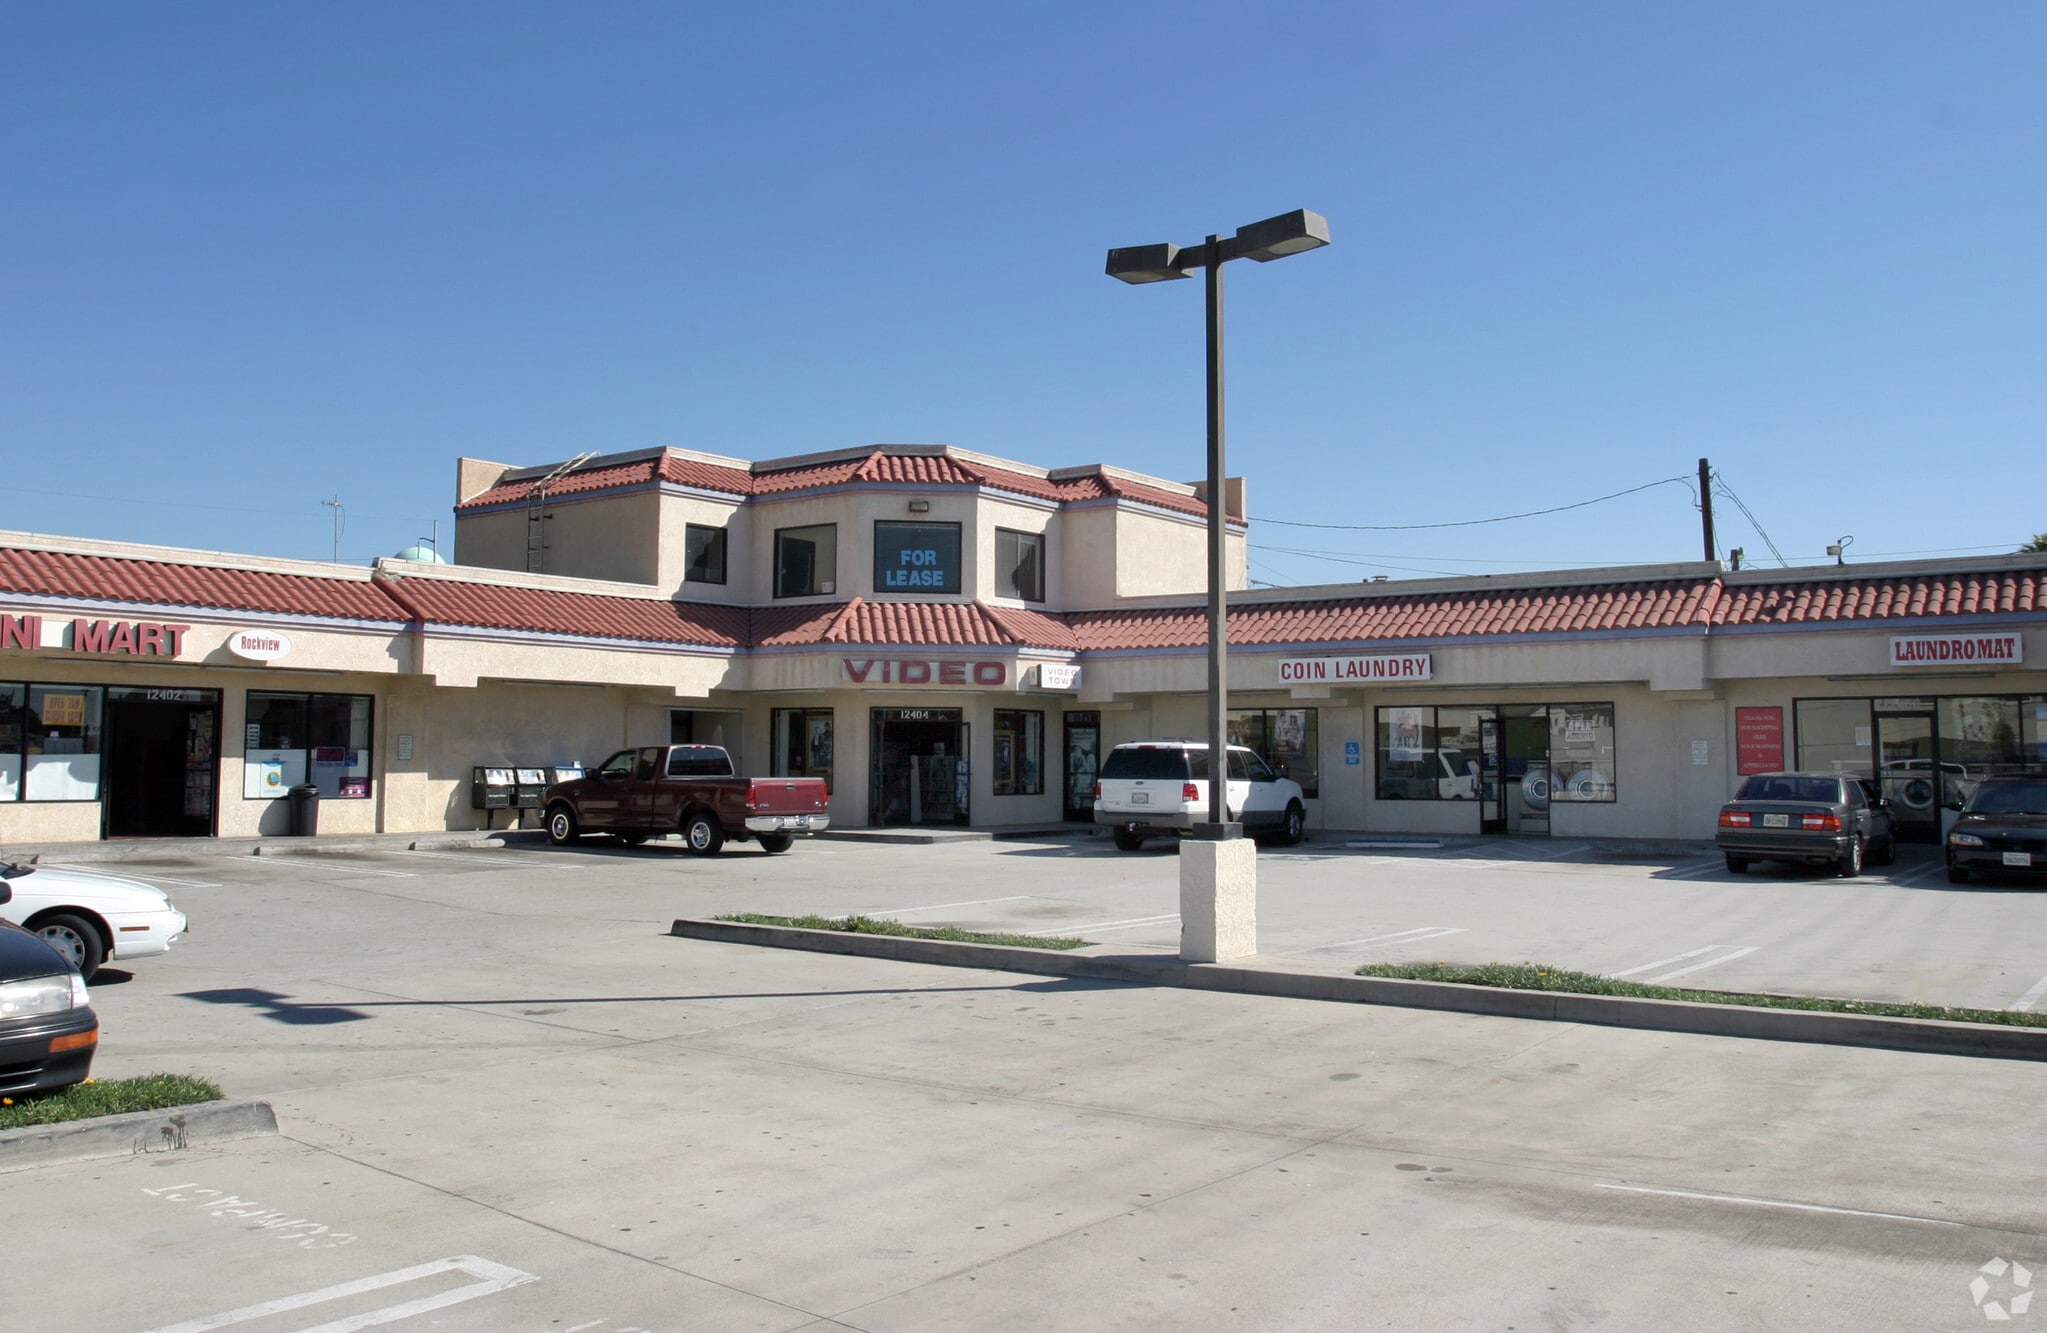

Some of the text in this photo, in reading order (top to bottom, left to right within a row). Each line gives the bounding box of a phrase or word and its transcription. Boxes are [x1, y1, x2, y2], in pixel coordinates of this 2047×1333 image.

[901, 549, 937, 566] FOR
[886, 570, 944, 586] LEASE
[0, 613, 191, 656] NI MART
[241, 635, 280, 652] Rockview
[1894, 637, 2015, 661] LAUNDROMAT
[842, 658, 1006, 685] VIDEO
[1048, 668, 1077, 676] VIDEO
[1281, 658, 1426, 680] COIN LAUNDRY
[1049, 676, 1076, 685] TOWN
[147, 689, 181, 700] 12402
[900, 710, 929, 720] 12404
